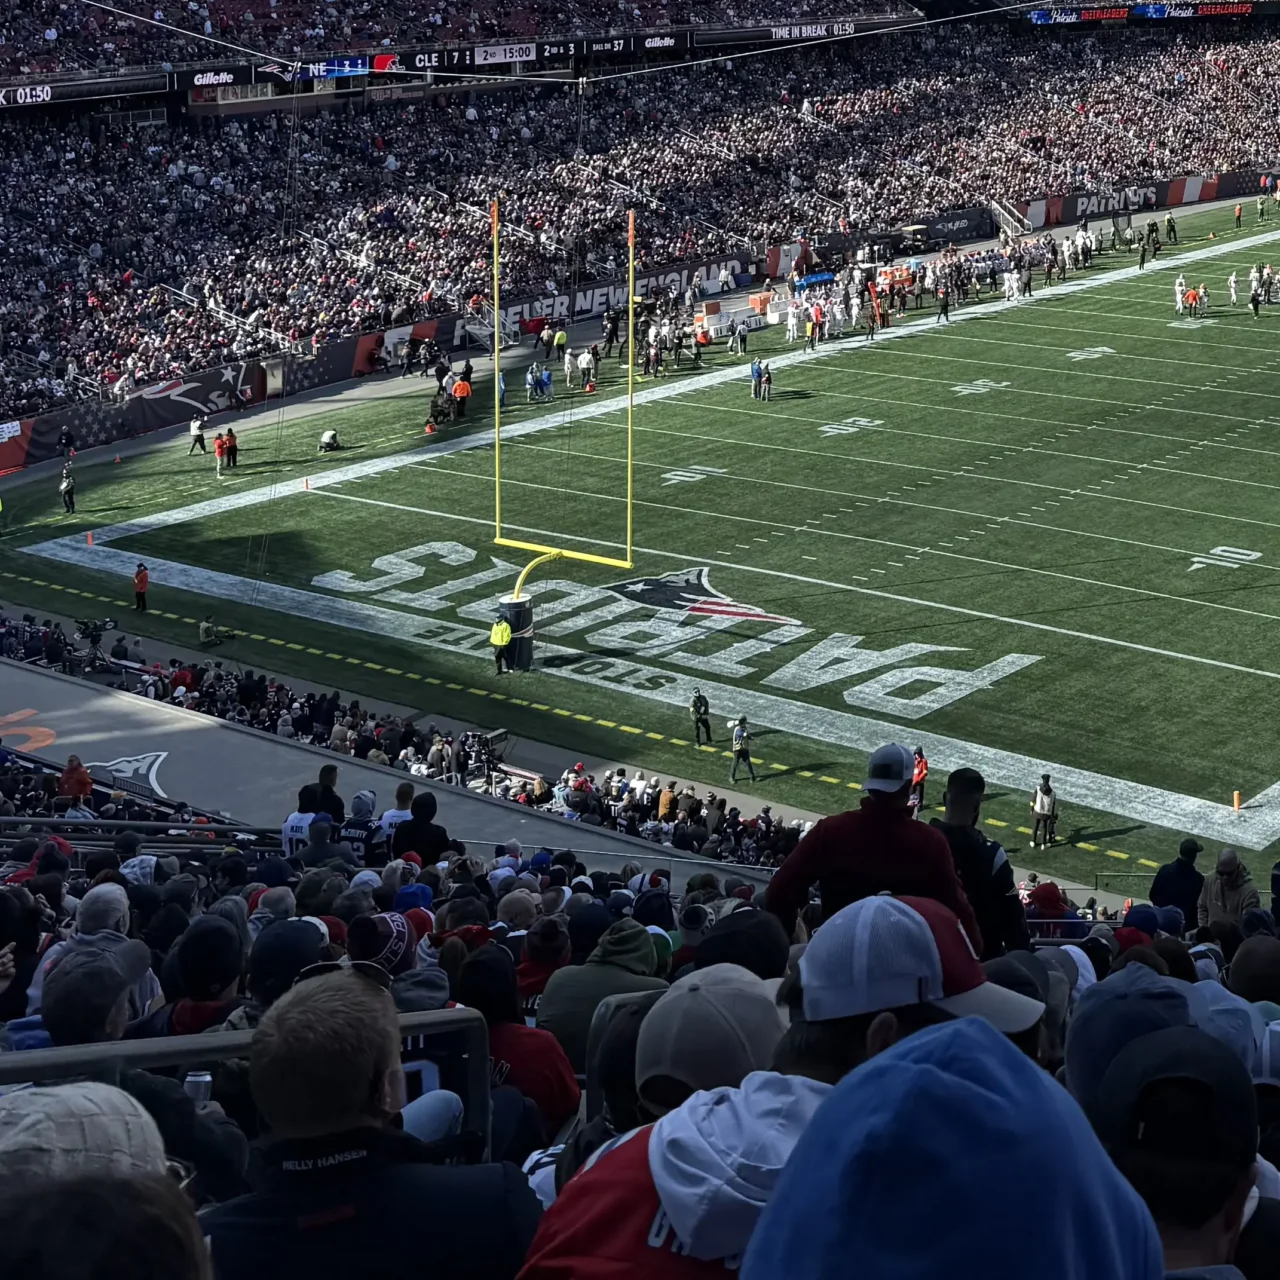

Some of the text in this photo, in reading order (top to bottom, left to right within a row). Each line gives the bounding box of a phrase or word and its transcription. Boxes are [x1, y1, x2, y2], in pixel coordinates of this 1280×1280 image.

[1165, 3, 1253, 19] Patriots CHEERLEADERS
[771, 23, 855, 39] TIME IN BREAK 01:50
[503, 46, 531, 61] 15:00
[568, 42, 575, 55] 3
[613, 40, 624, 52] 37
[644, 36, 676, 49] Gillette
[309, 58, 350, 77] NE 3
[416, 50, 459, 68] CLE 7
[194, 70, 234, 86] Gillette
[16, 85, 52, 104] 01:50
[574, 285, 628, 312] NEW
[817, 417, 885, 435] 20
[661, 464, 728, 483] 10
[1190, 545, 1263, 569] 10
[312, 540, 1044, 719] PATRIOTS
[282, 1149, 368, 1171] HELLY HANSEN
